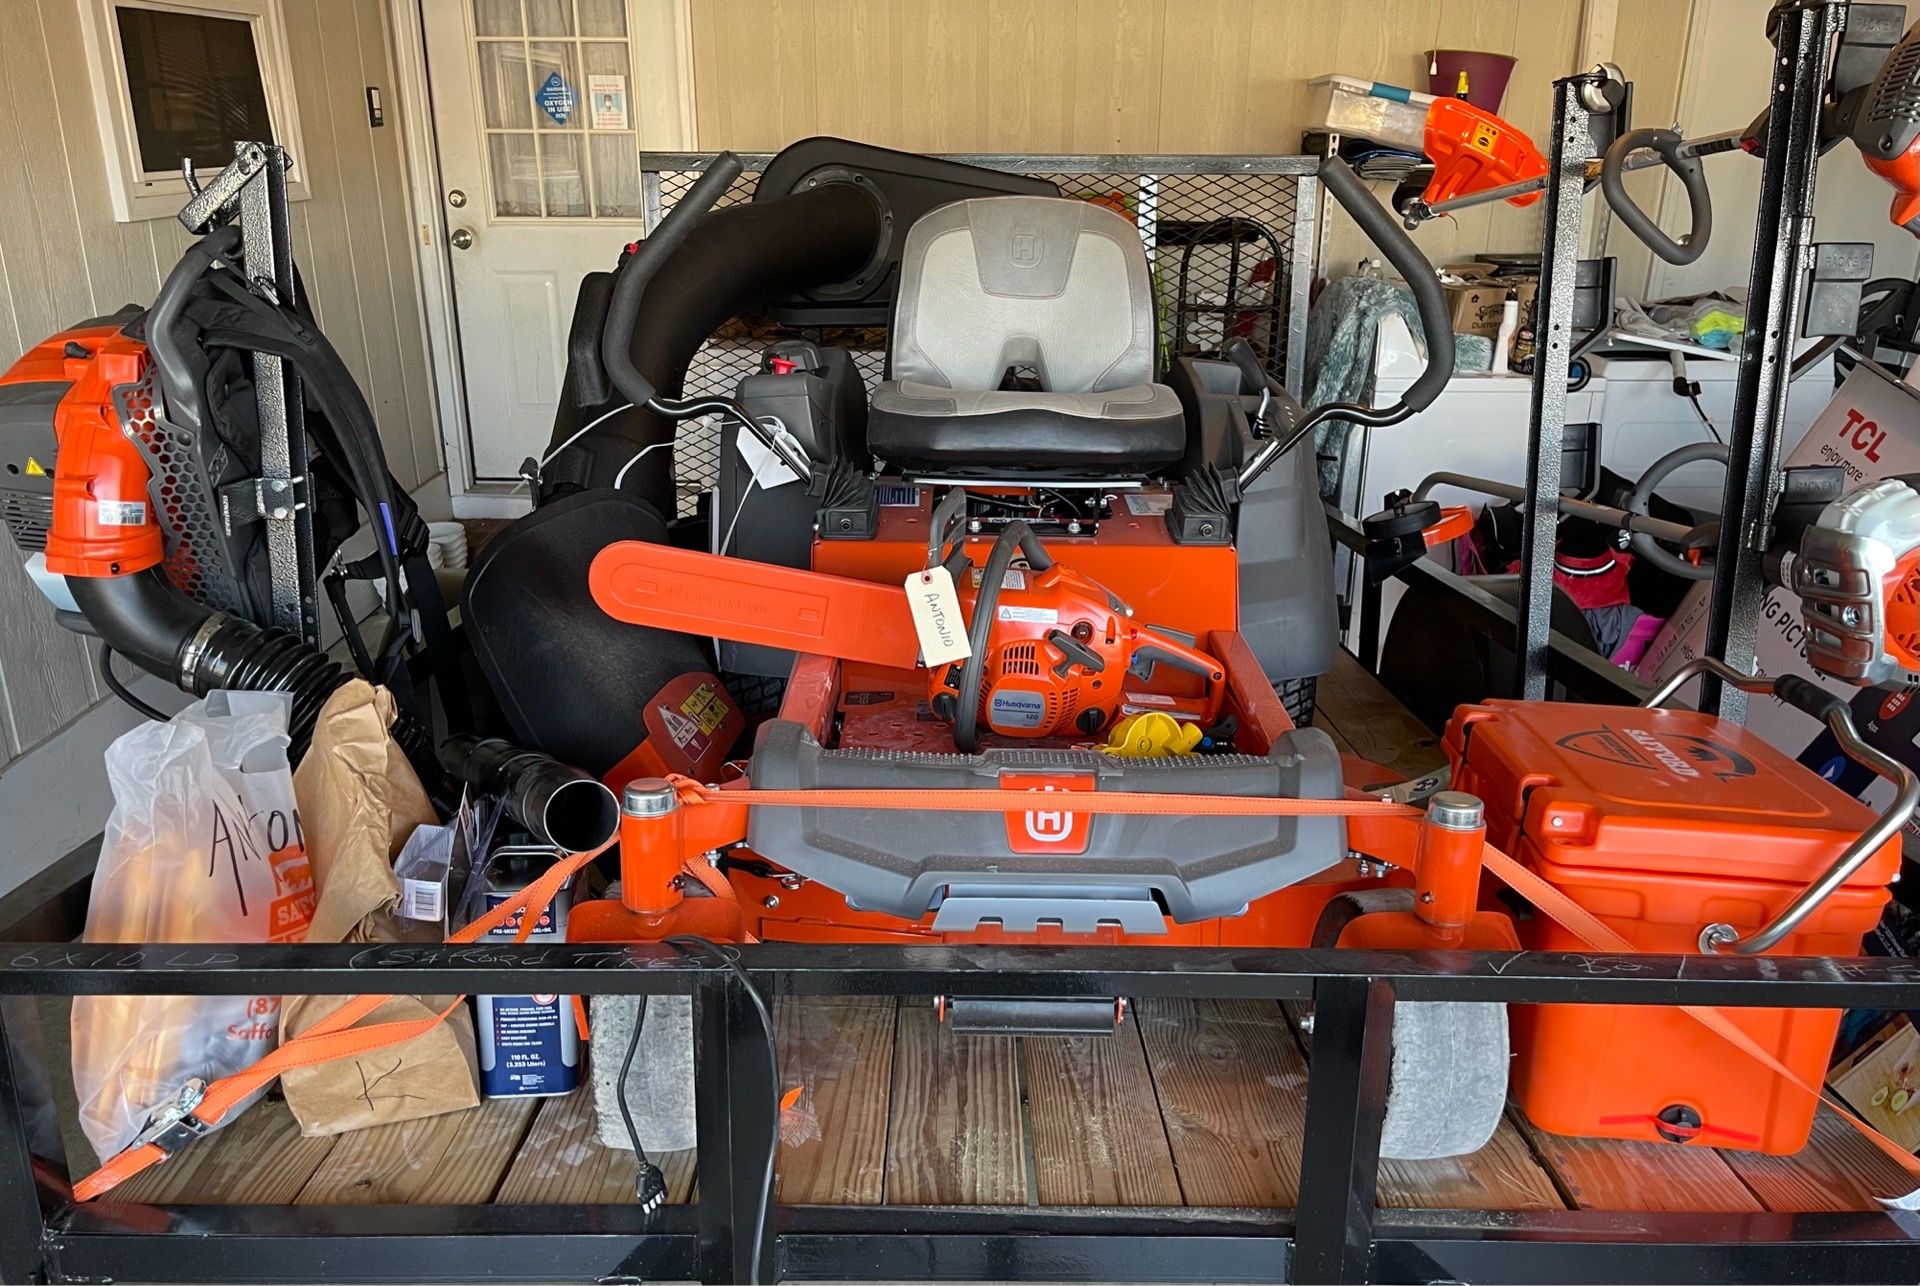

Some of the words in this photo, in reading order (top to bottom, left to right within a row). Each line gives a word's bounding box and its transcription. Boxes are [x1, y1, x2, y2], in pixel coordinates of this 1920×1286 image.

[1839, 408, 1887, 464] TCL
[1820, 444, 1843, 466] enjoy
[1842, 459, 1863, 482] more
[924, 592, 954, 648] ANTONIO
[1002, 700, 1041, 709] Husqvarna
